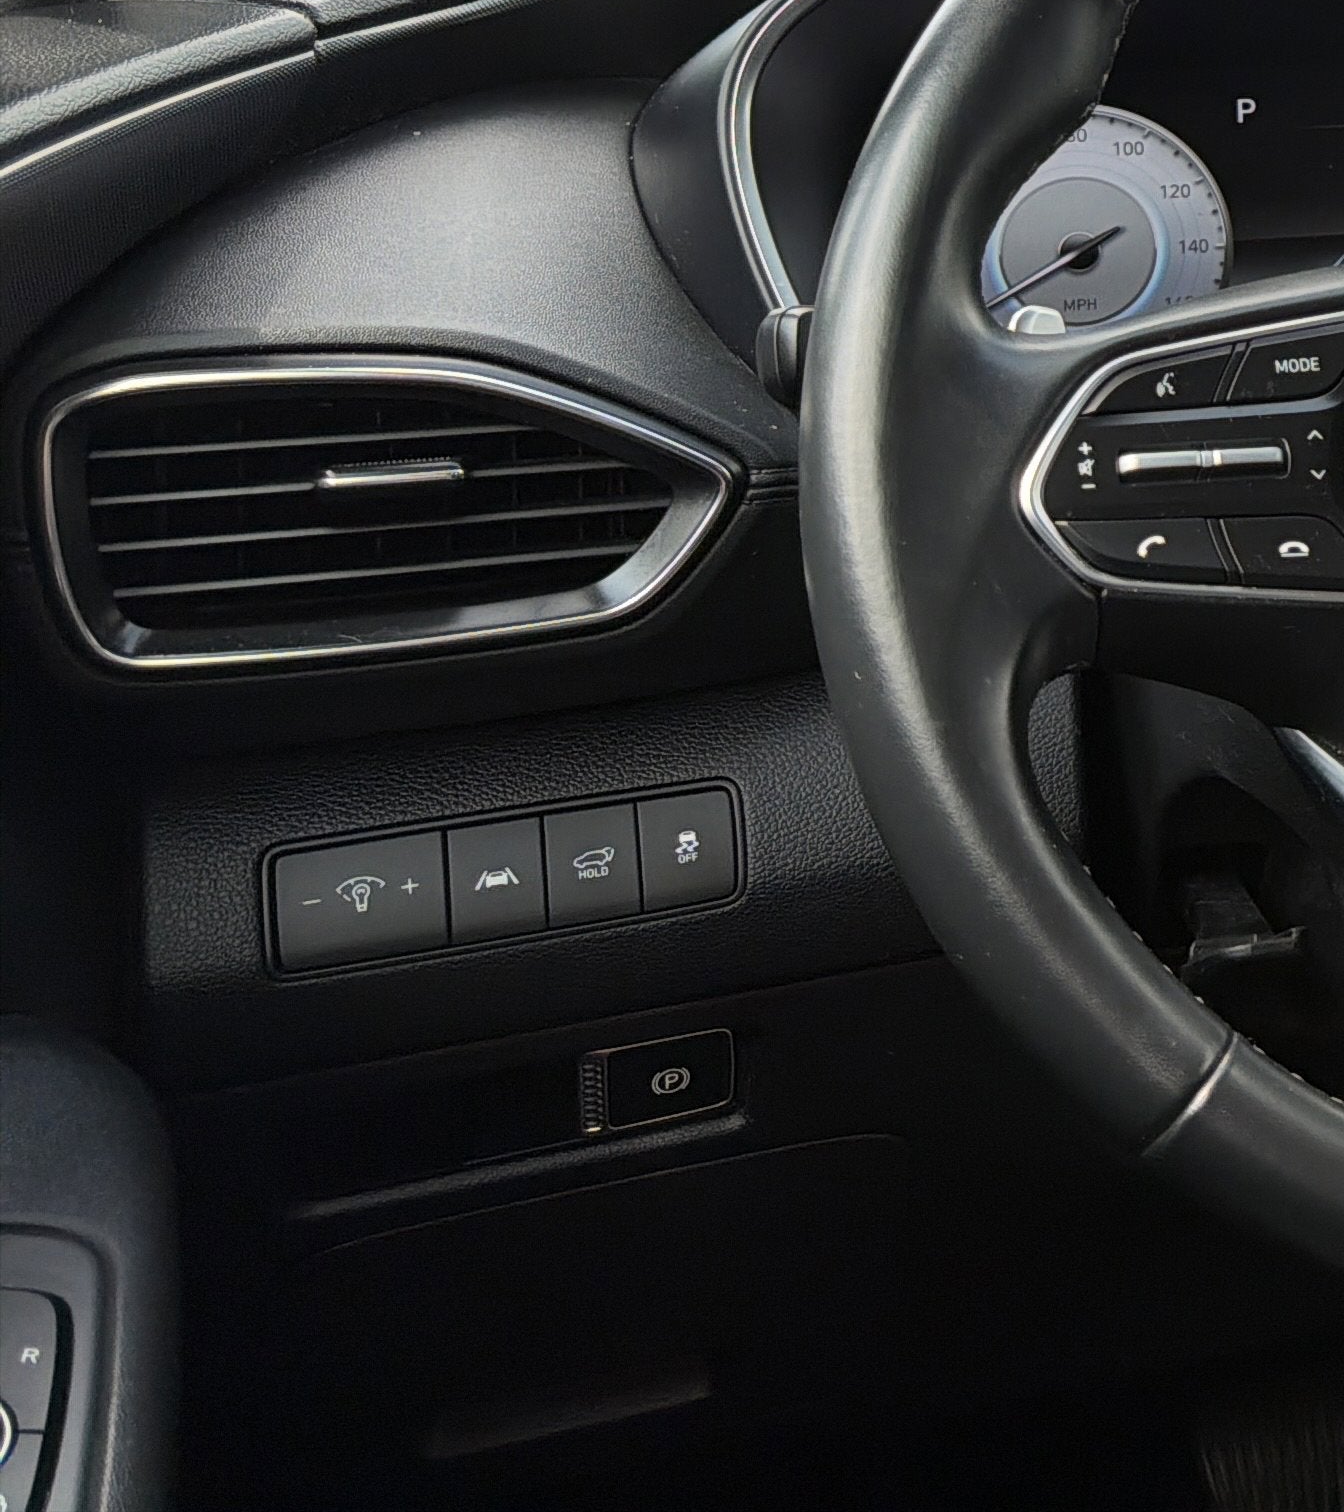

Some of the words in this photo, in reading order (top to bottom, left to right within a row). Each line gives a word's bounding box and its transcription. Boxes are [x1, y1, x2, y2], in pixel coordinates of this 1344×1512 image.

[1235, 97, 1257, 124] P
[1113, 141, 1145, 156] 100
[1160, 183, 1191, 199] 120
[1178, 239, 1209, 255] 140
[1063, 298, 1097, 311] MPH
[1273, 357, 1321, 374] MODE
[678, 852, 698, 864] OFF
[578, 866, 609, 880] HOLD
[20, 1346, 41, 1365] R
